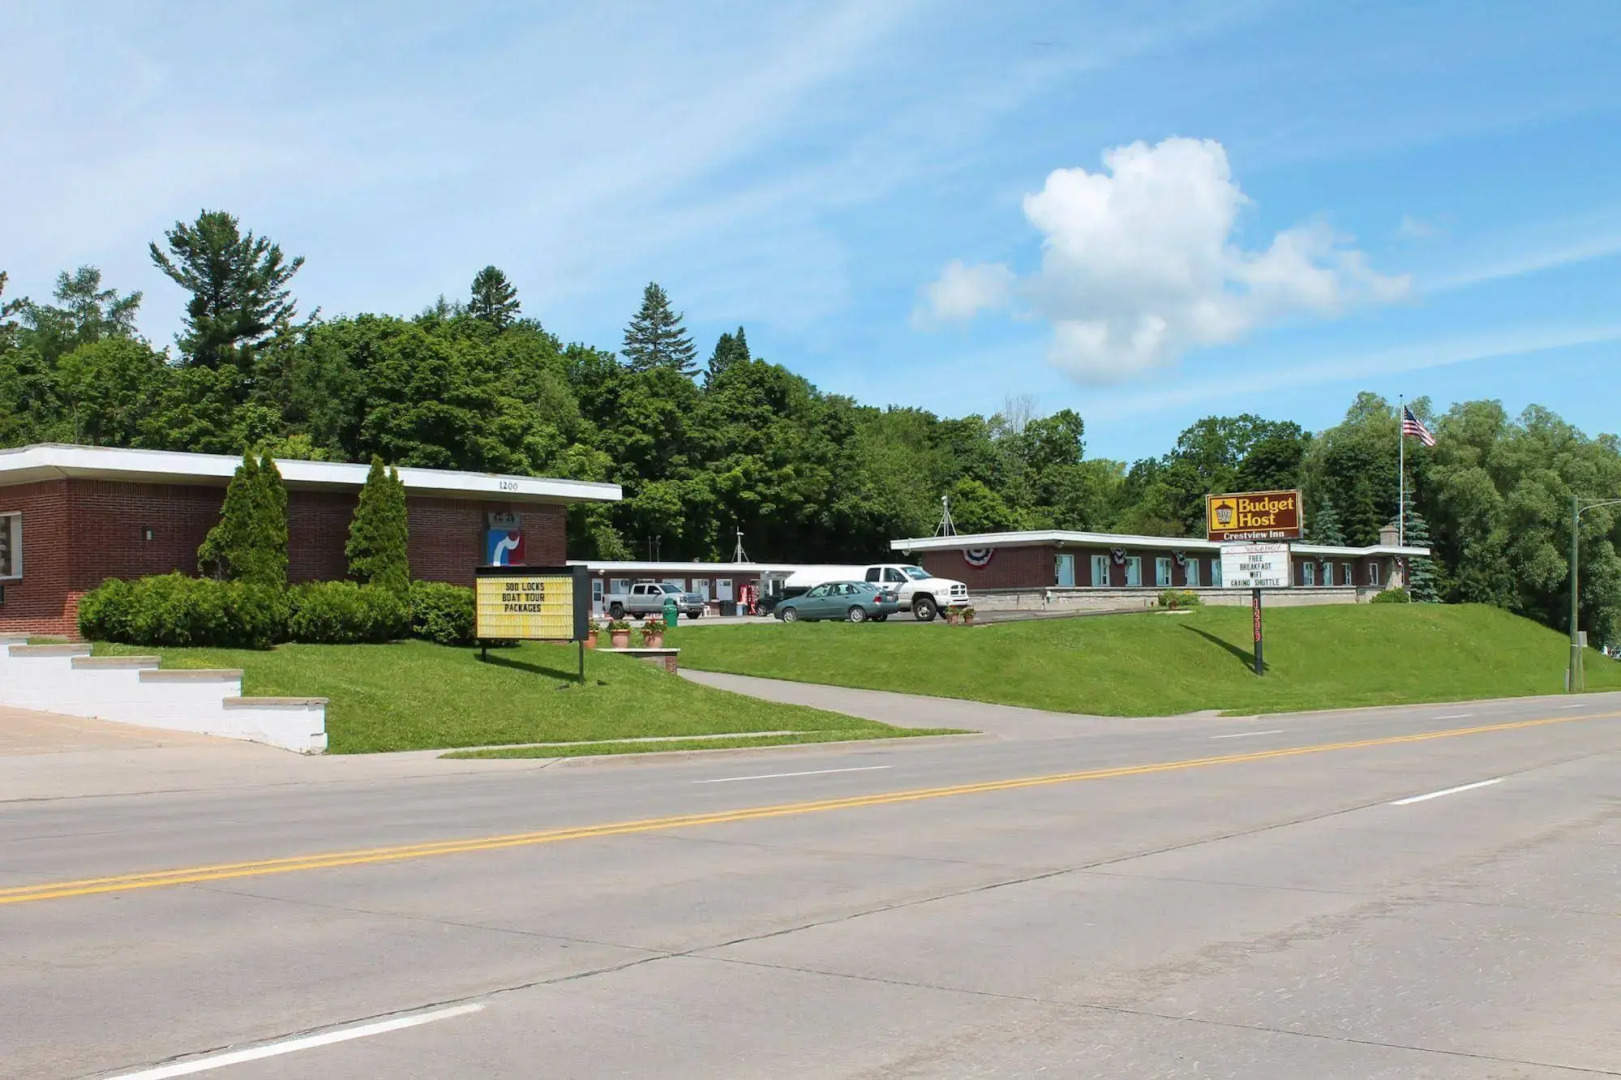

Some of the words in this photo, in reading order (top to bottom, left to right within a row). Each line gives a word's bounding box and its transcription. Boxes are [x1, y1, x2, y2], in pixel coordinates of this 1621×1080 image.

[499, 481, 518, 491] 1200
[1238, 497, 1294, 513] Budget
[1239, 513, 1276, 527] Host
[1223, 531, 1268, 540] Crestview
[1269, 530, 1285, 538] Inn
[1239, 562, 1271, 570] BREAKFAST
[522, 582, 544, 591] LOCKS
[1254, 578, 1280, 586] SHUTTLE
[502, 593, 520, 602] BOAT
[525, 593, 545, 602] TOUR
[504, 603, 541, 612] PACKAGES
